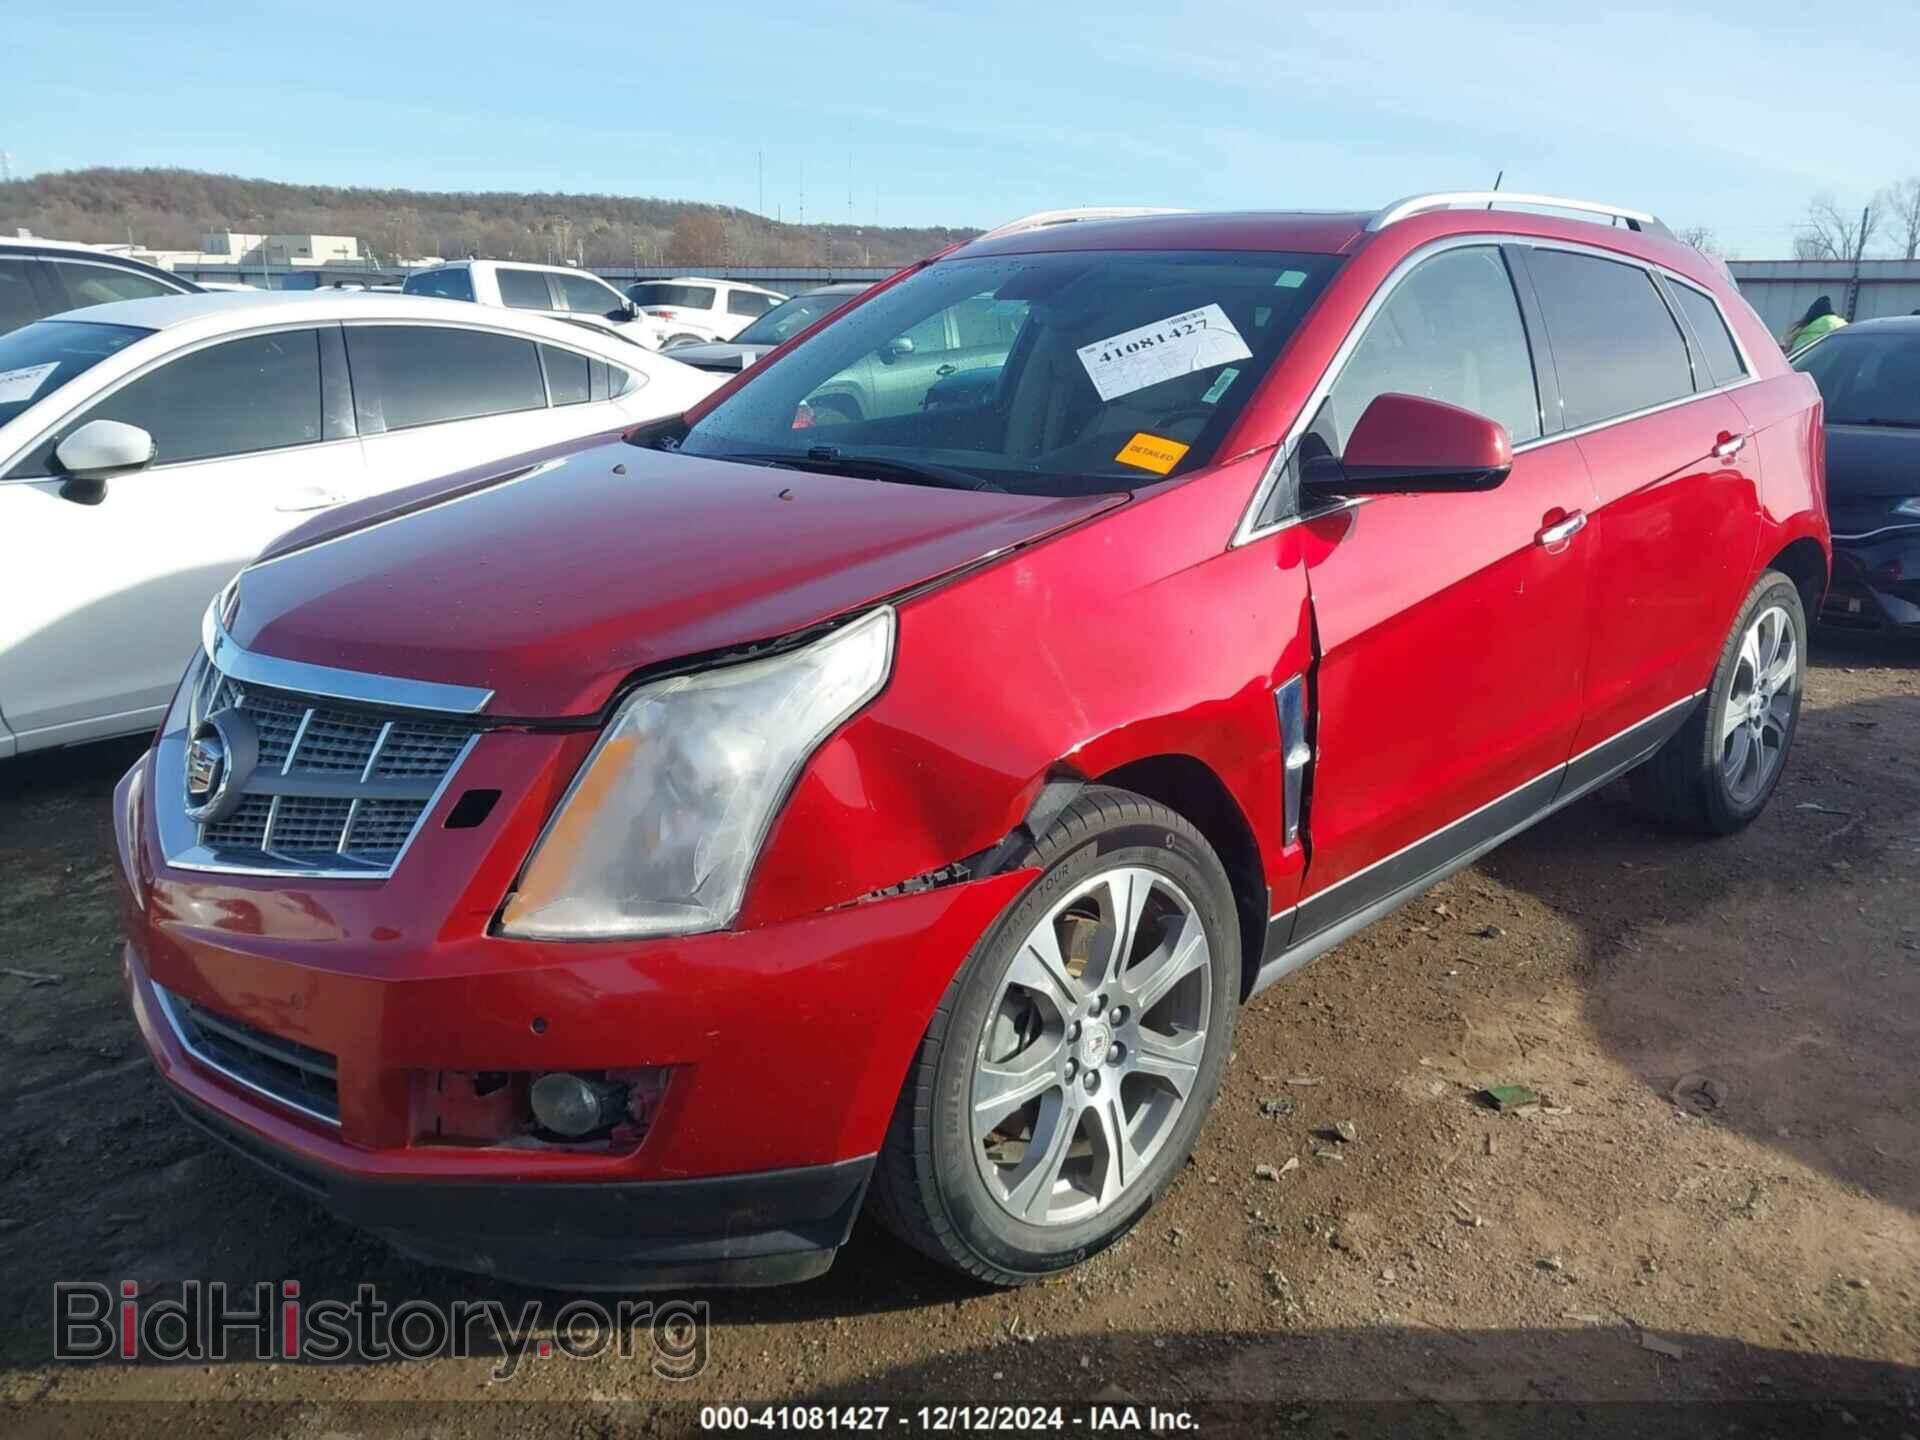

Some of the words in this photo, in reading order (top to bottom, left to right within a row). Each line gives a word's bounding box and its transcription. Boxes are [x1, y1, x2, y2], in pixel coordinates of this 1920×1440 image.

[1099, 319, 1208, 364] 41081427
[1129, 444, 1174, 462] DETAILED
[1039, 864, 1069, 897] TOUR
